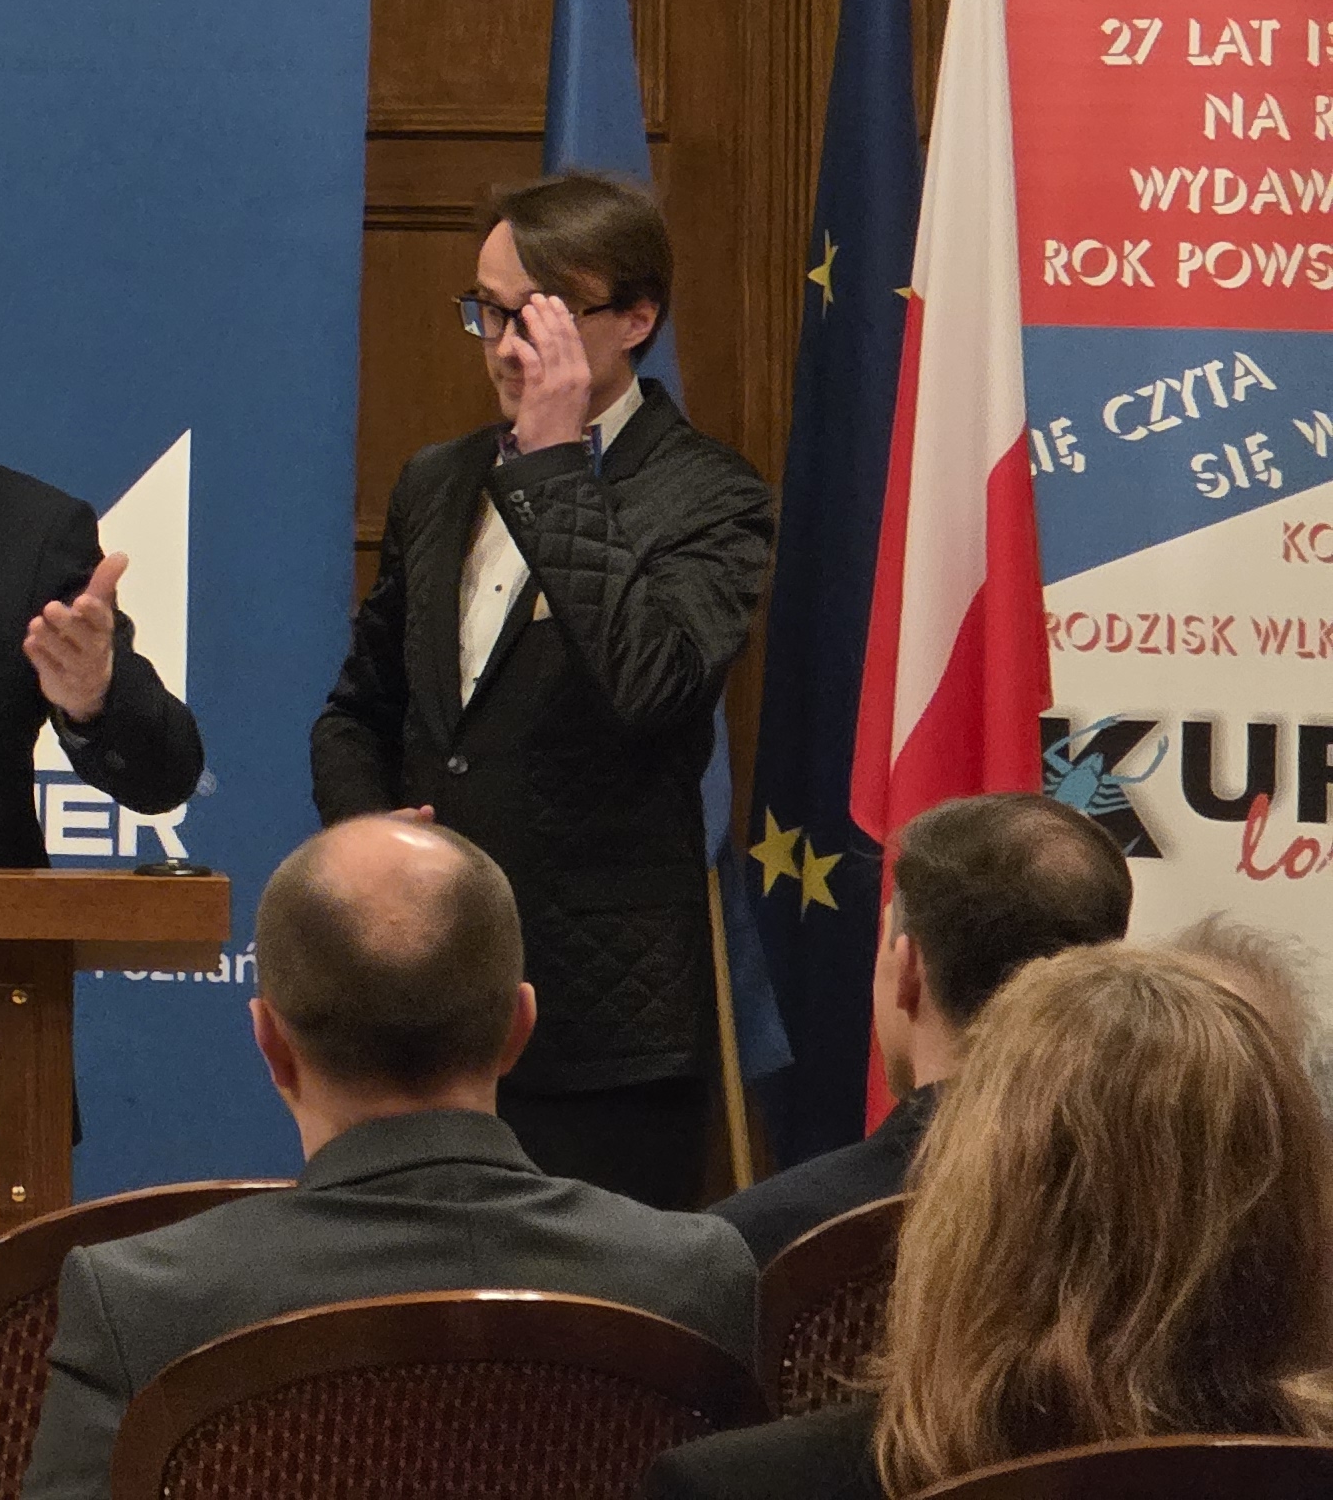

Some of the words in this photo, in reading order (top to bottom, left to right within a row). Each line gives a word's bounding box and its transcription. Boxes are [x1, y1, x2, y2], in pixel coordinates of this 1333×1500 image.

[1100, 17, 1163, 67] 27
[1186, 17, 1281, 67] LAT
[1306, 18, 1333, 67] I
[1203, 91, 1291, 141] NA
[1129, 165, 1333, 215] WYDAW
[1043, 238, 1155, 287] ROK
[1176, 240, 1333, 290] POWS
[1030, 416, 1086, 477] IĘ
[1102, 350, 1278, 442] CZYTA
[1190, 431, 1283, 499] SIĘ
